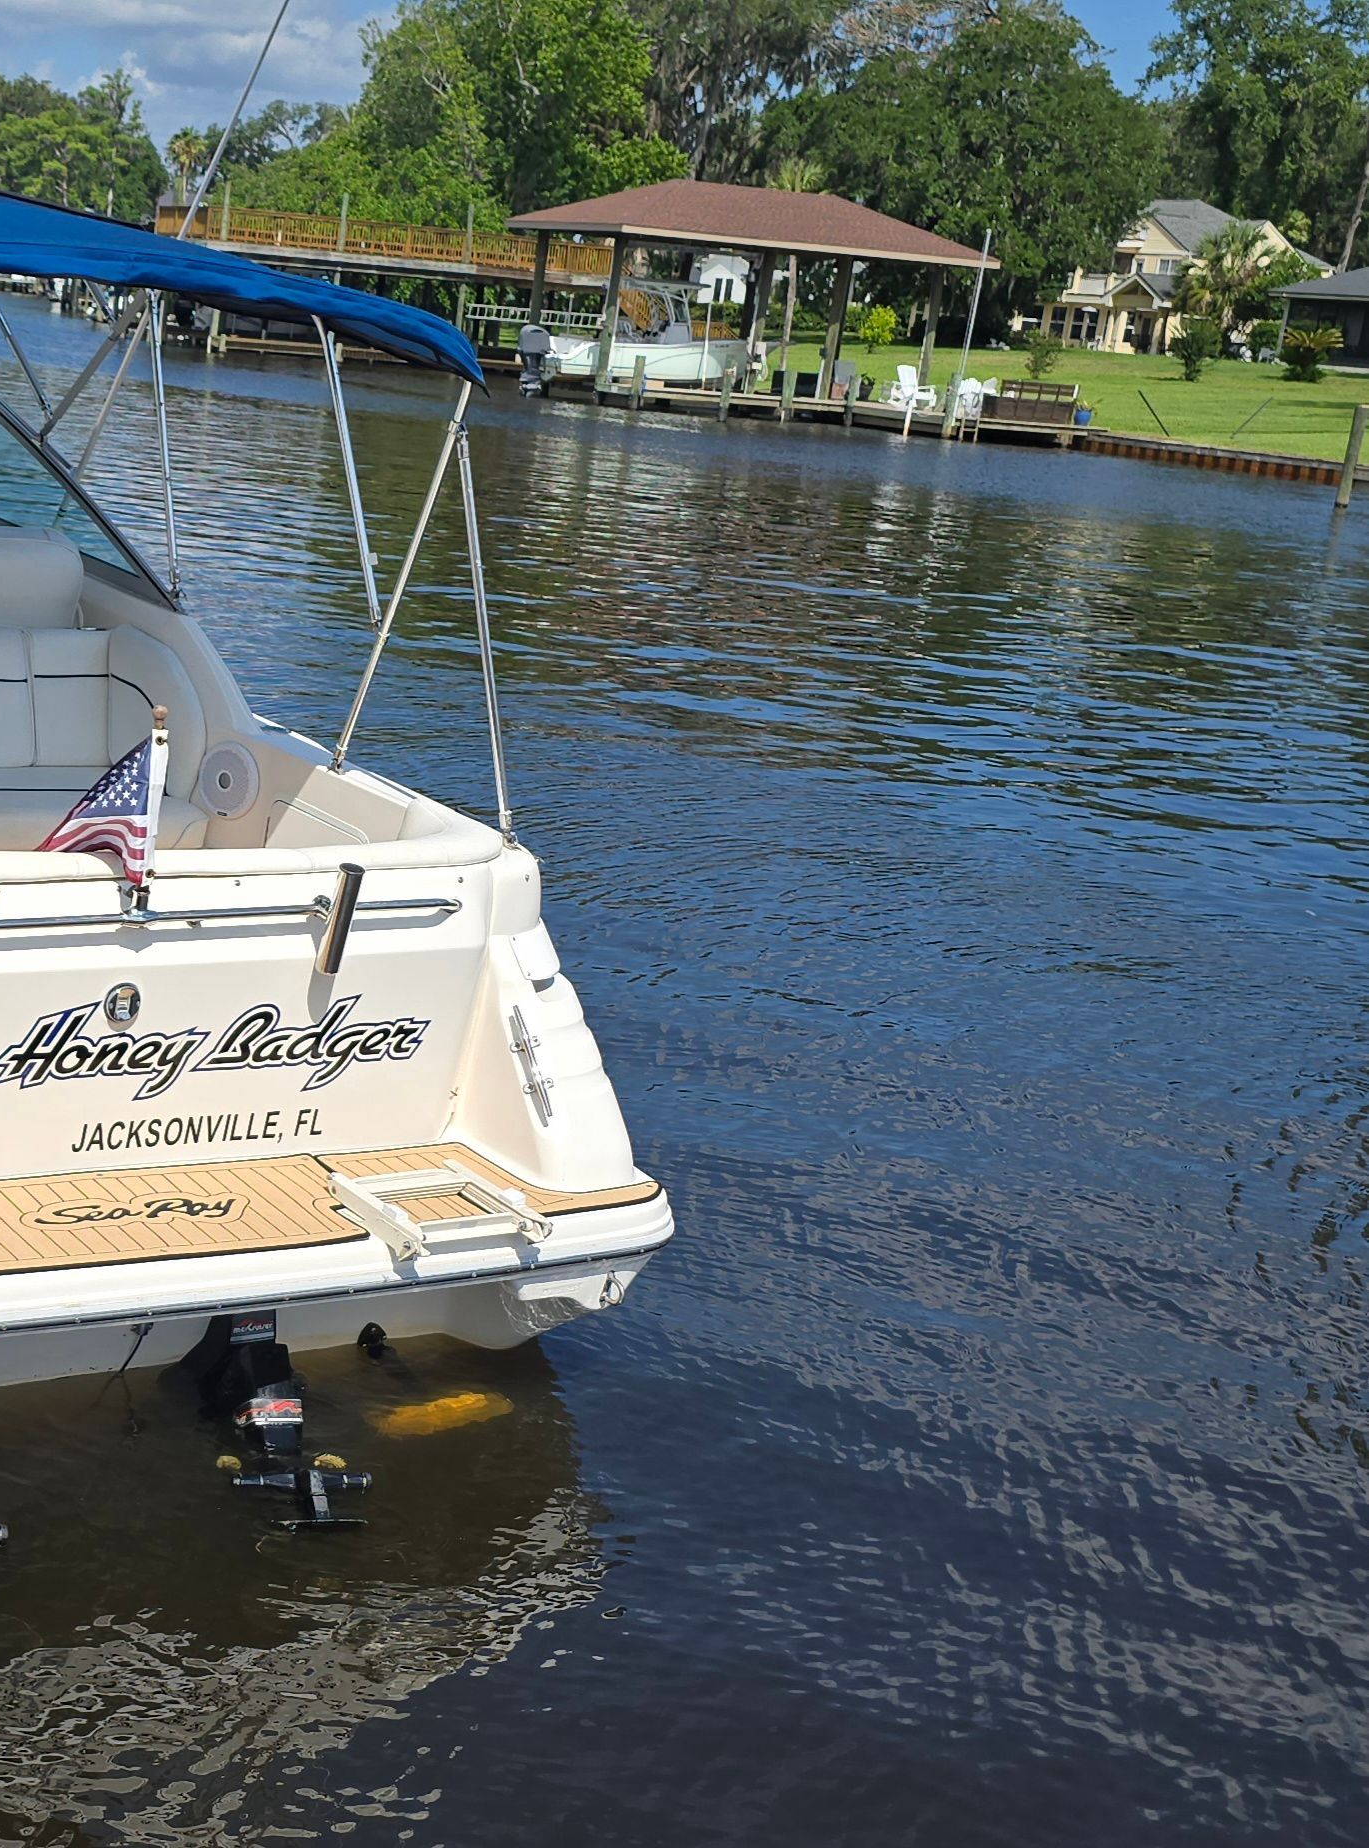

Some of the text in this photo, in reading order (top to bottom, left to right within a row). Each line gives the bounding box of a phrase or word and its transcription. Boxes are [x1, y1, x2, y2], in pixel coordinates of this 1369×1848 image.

[189, 994, 431, 1092] Badger
[71, 1108, 322, 1153] JACKSONVILLE, FL
[34, 1197, 237, 1225] Sea Ray
